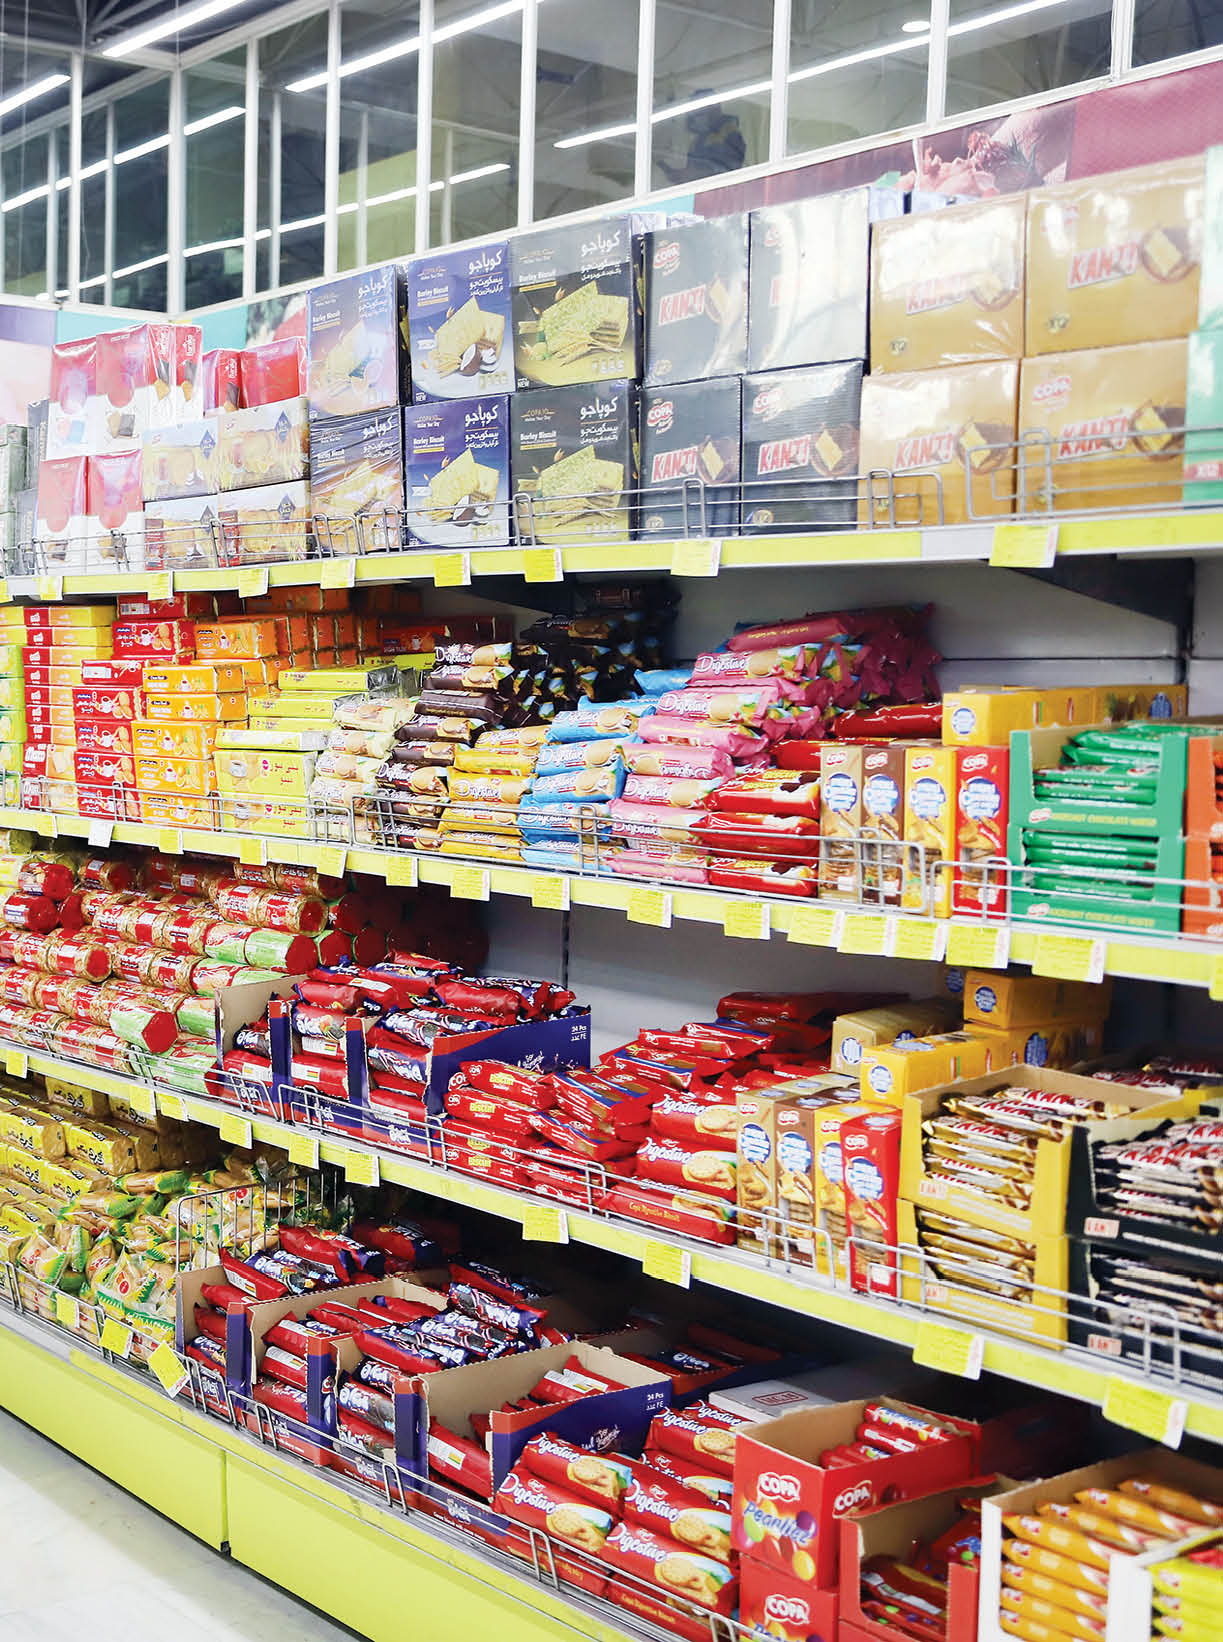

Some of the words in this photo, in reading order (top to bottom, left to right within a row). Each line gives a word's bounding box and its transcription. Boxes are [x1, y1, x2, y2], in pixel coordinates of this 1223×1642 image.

[469, 249, 502, 274] کوپاجو
[465, 404, 498, 427] کوپاجو
[580, 397, 618, 420] کوپاجو
[520, 431, 537, 442] Barley
[695, 655, 749, 676] Digestive
[652, 1093, 708, 1116] Digestive
[636, 1136, 694, 1165] Digestive
[654, 1407, 709, 1434] Digestive
[684, 1400, 743, 1427] Digestive
[527, 1431, 581, 1462] Digestive
[499, 1472, 556, 1514] Digestive
[759, 1474, 800, 1499] COPA
[834, 1485, 870, 1509] COPA
[625, 1478, 680, 1522] Digestive
[607, 1522, 667, 1562] Digestive
[766, 1598, 810, 1625] COPA
